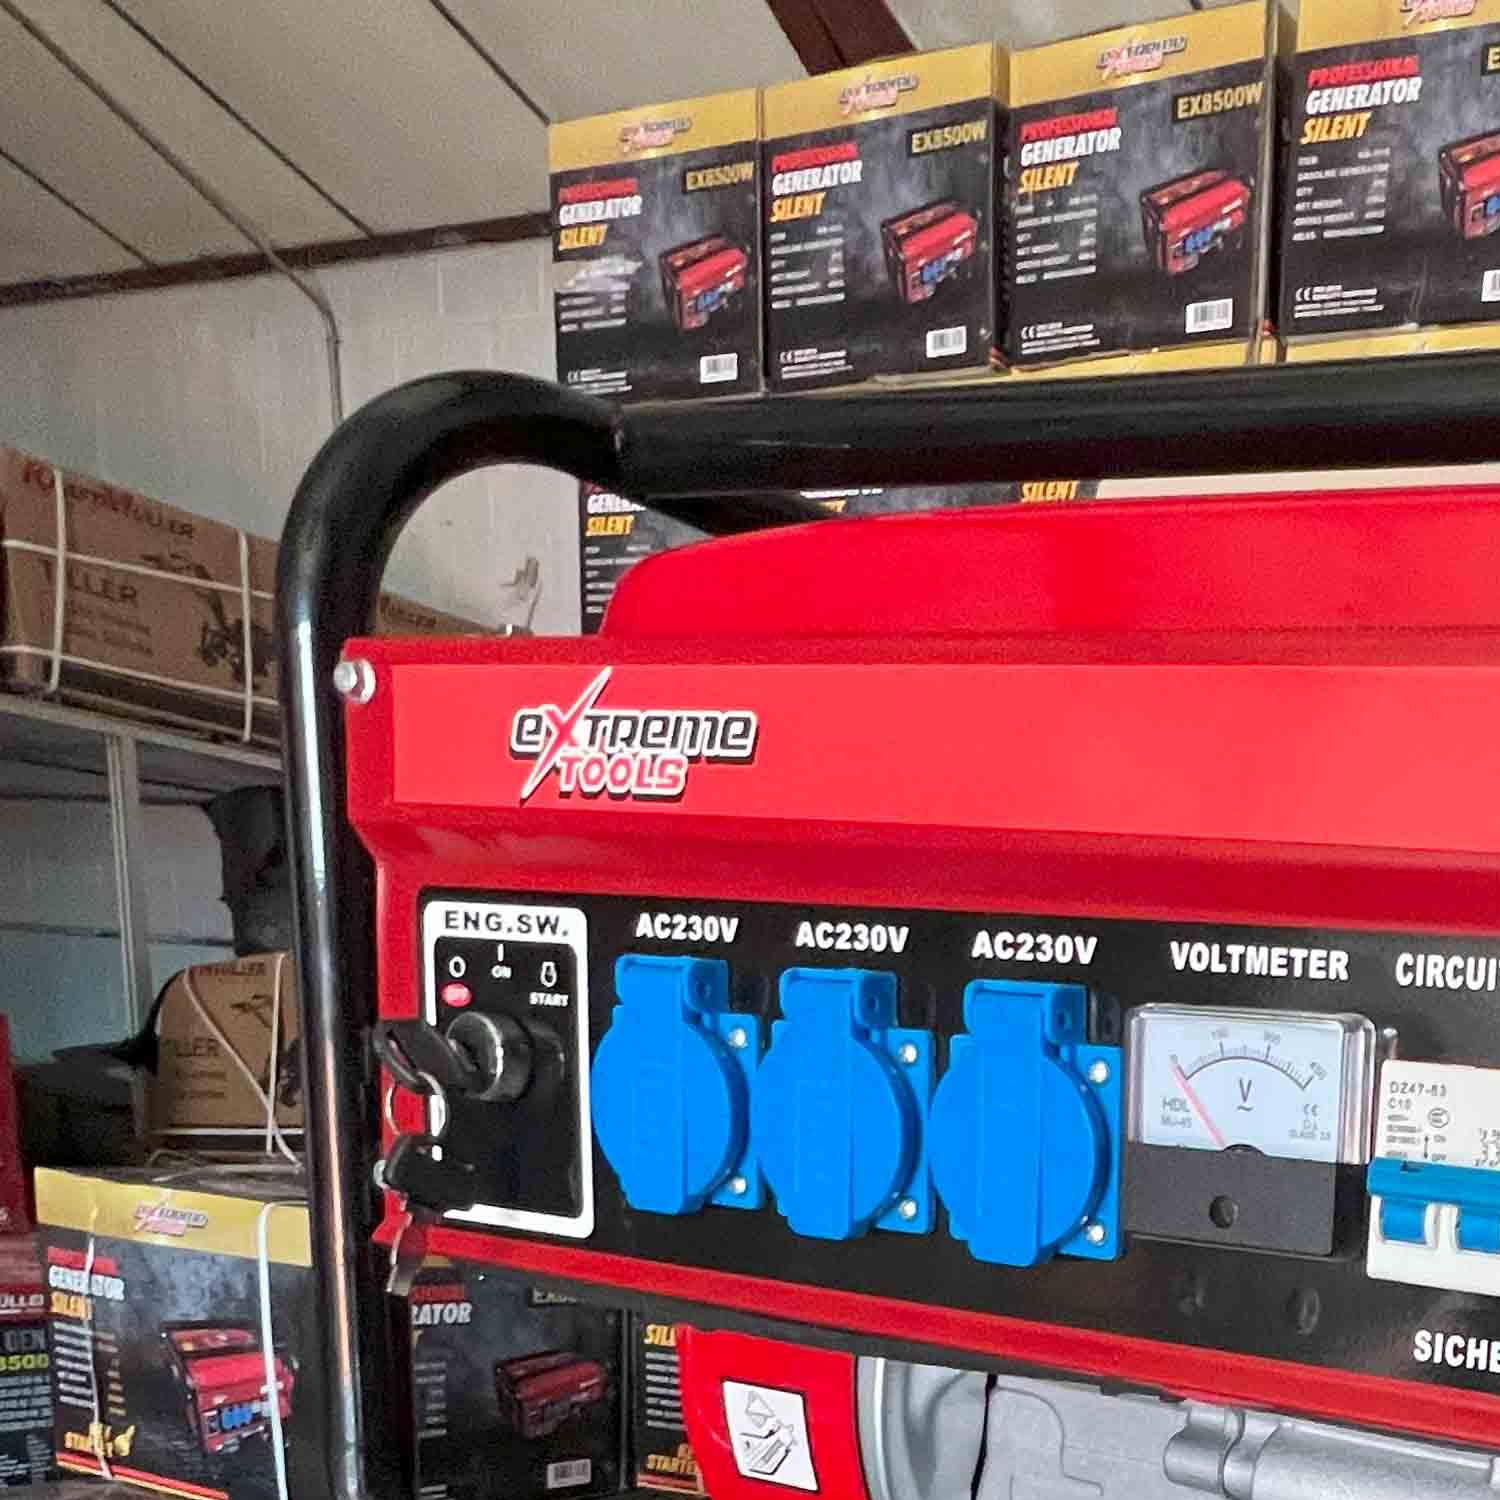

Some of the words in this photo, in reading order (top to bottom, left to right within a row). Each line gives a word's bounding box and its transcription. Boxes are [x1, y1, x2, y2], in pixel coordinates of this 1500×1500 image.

[1177, 82, 1264, 119] EX8500W
[1305, 77, 1422, 115] GENERATOR
[1300, 111, 1372, 144] SILENT
[1021, 127, 1121, 167] GENERATOR
[772, 160, 863, 196] GENERATOR
[1018, 162, 1079, 193] SILENT
[559, 196, 642, 226] GENERATOR
[770, 192, 826, 223] SILENT
[1020, 480, 1079, 503] SILENT
[556, 752, 689, 804] TOOLS
[635, 913, 739, 944] AC230V
[795, 922, 909, 954] AC230V
[970, 930, 1098, 965] AC230V
[1169, 941, 1350, 981] VOLTMETER
[529, 991, 569, 1007] START
